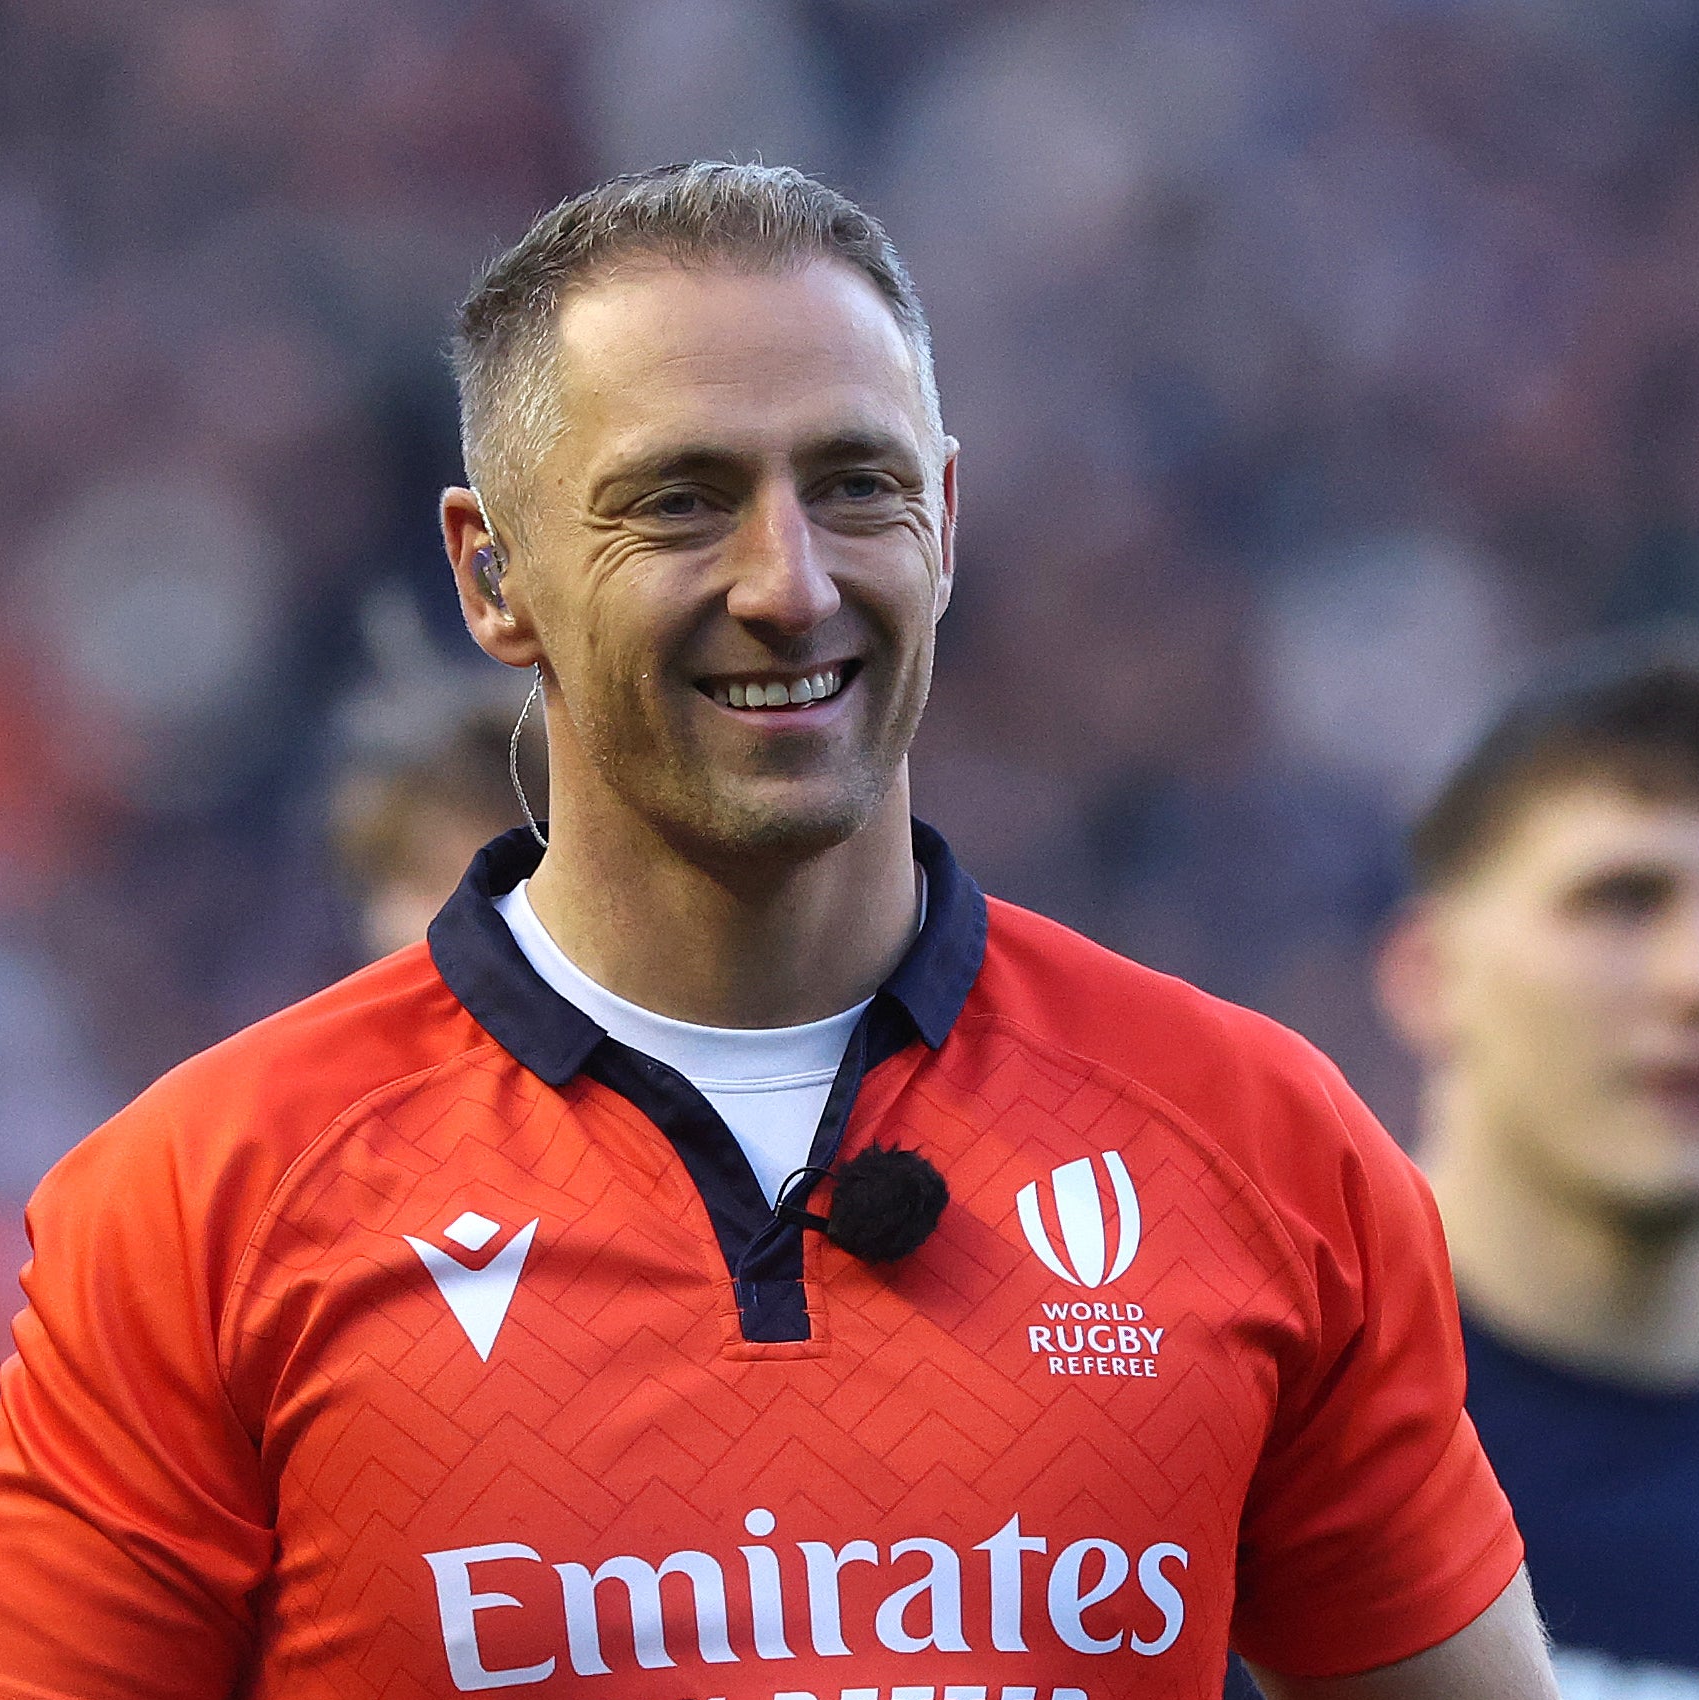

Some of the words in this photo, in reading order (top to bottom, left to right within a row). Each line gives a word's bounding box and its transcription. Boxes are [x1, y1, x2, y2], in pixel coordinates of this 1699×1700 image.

[1041, 1302, 1144, 1321] WORLD
[1027, 1325, 1164, 1355] RUGBY
[1048, 1356, 1158, 1378] REFEREE
[421, 1508, 1189, 1692] Emirates
